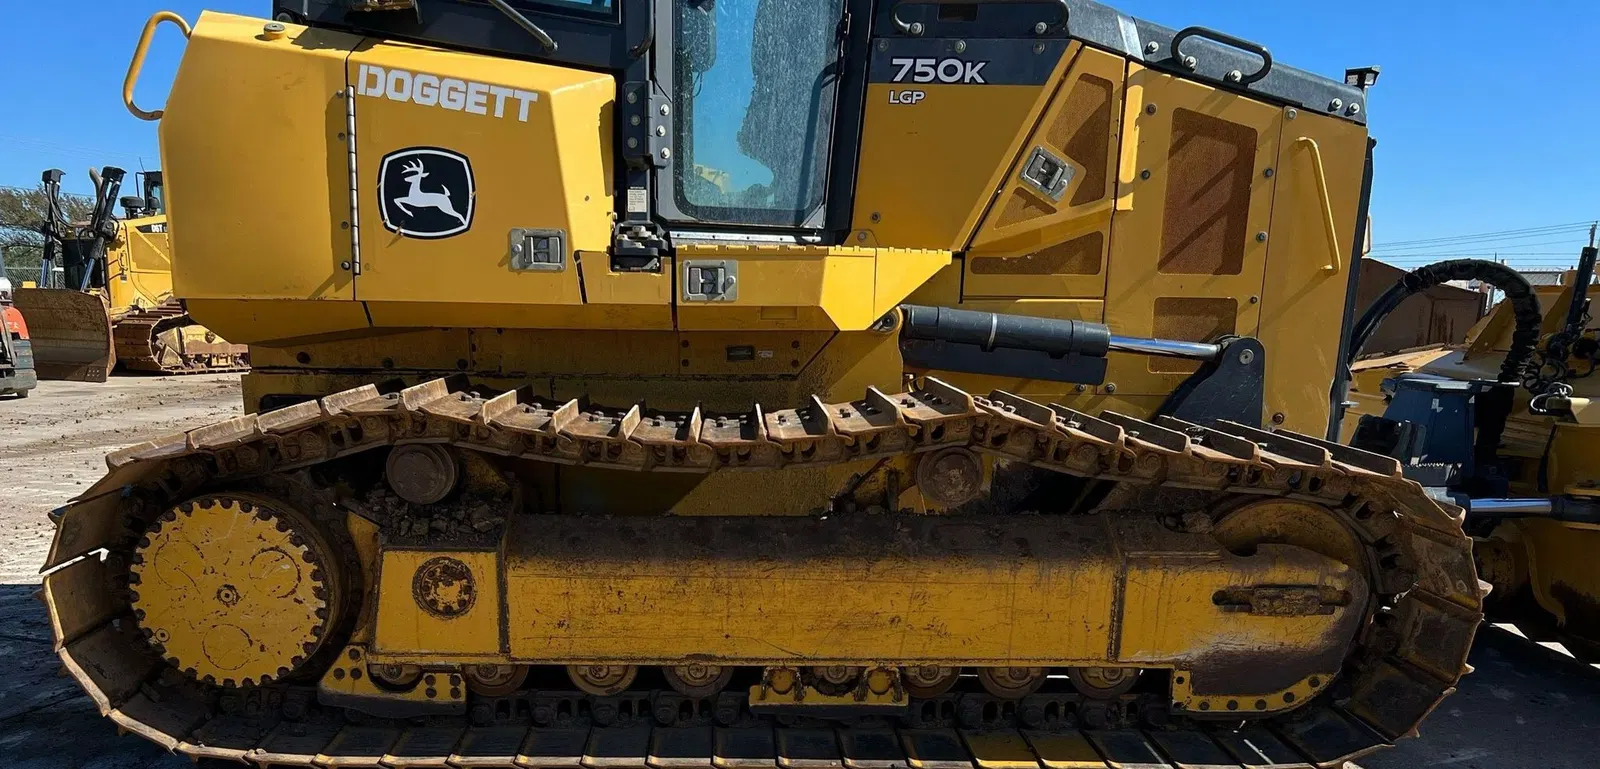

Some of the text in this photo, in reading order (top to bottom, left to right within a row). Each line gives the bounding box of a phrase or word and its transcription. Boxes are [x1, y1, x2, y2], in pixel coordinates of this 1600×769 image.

[891, 57, 987, 84] 750K
[357, 63, 538, 122] DOGGETT
[889, 90, 926, 104] LGP
